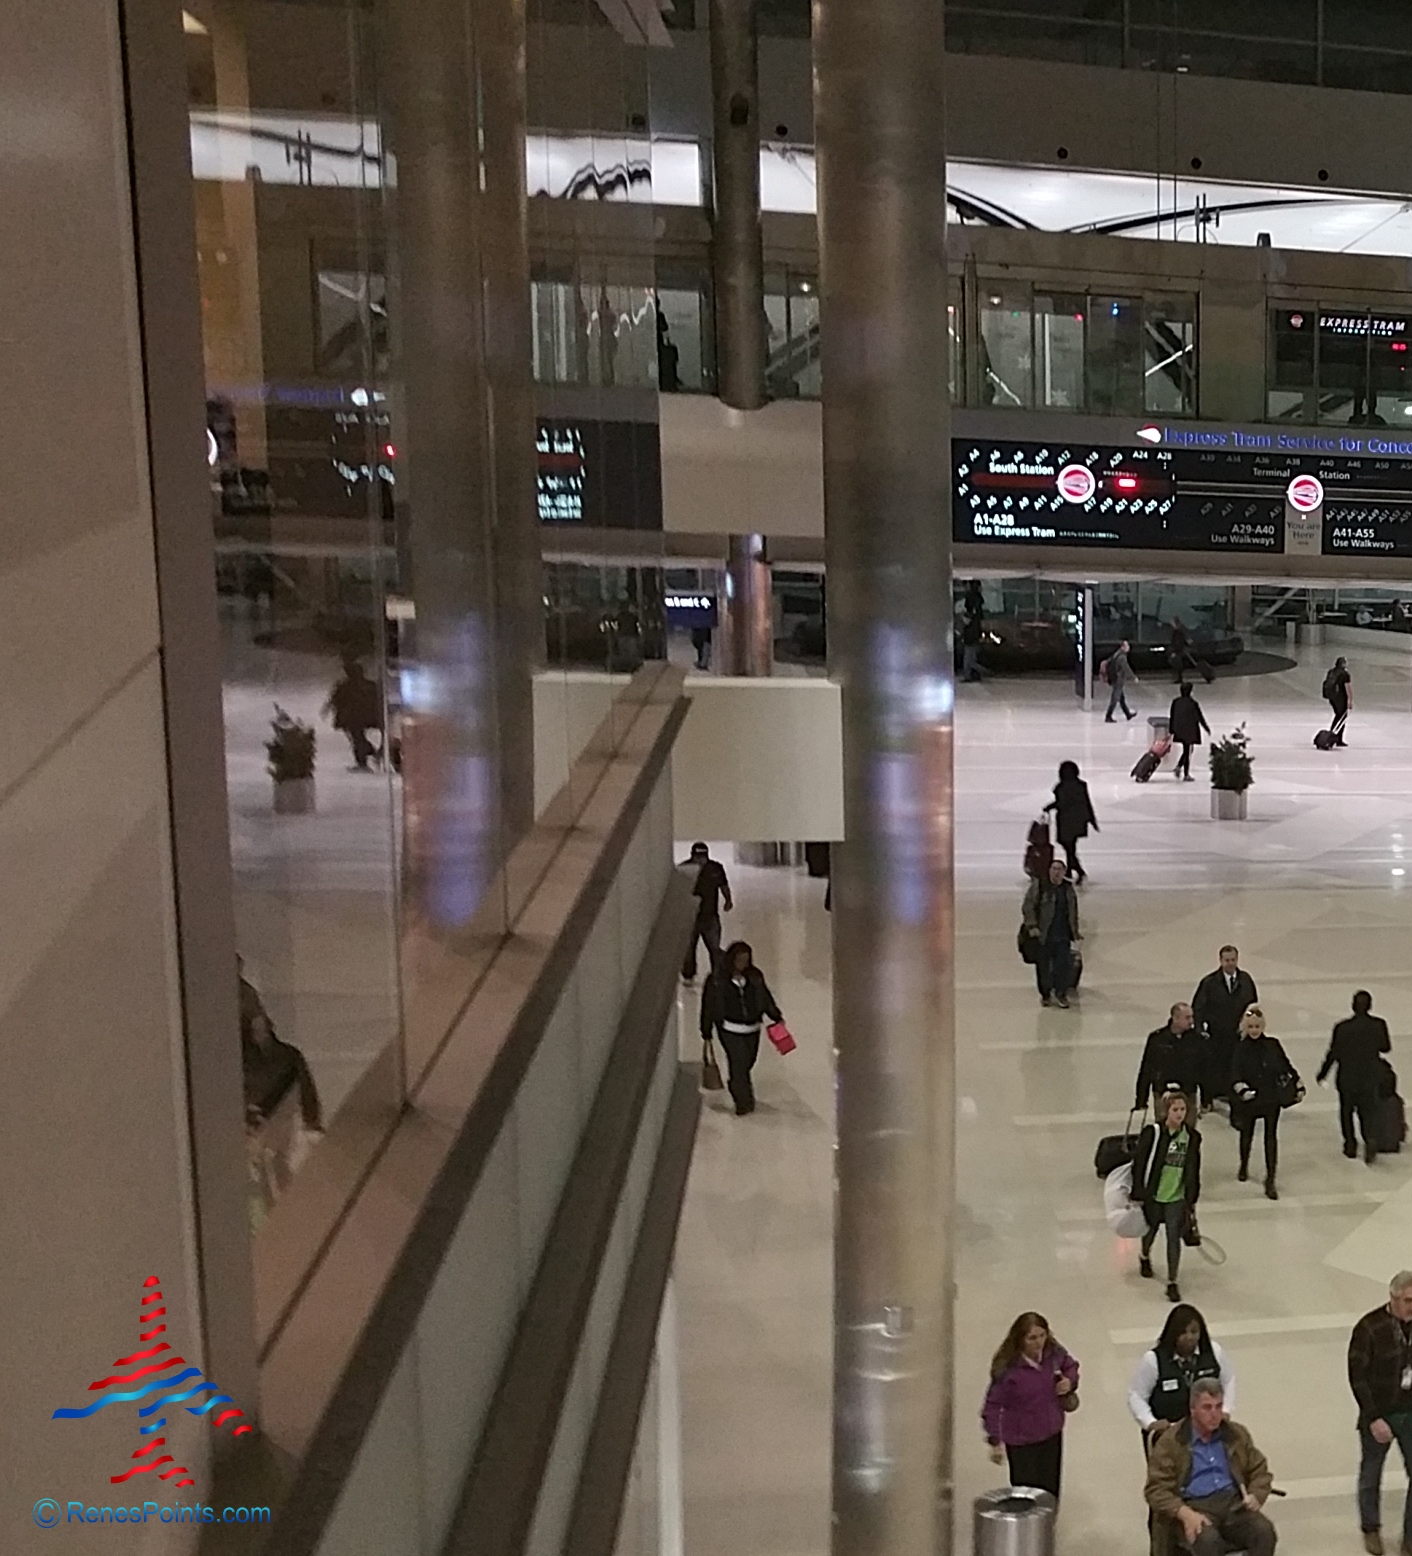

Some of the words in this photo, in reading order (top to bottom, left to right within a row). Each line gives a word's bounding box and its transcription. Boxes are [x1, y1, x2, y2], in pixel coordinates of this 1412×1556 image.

[1320, 317, 1369, 329] EXPRESS
[1373, 320, 1405, 331] TRAM
[1164, 427, 1227, 447] Express
[1232, 431, 1271, 447] Tram
[1278, 433, 1335, 449] Service
[1339, 437, 1363, 452] for
[1132, 450, 1148, 459] A24
[1156, 452, 1172, 460] A28
[989, 462, 1018, 474] South
[1020, 463, 1054, 475] Station
[1320, 459, 1334, 467] A40
[1253, 467, 1290, 477] Terminal
[1319, 470, 1350, 480] Station
[973, 512, 1015, 526] A1-A28
[1231, 524, 1275, 535] A29-A40
[1287, 521, 1305, 530] You
[974, 525, 992, 535] Use
[994, 525, 1030, 538] Express
[1031, 526, 1056, 538] Tram
[1293, 530, 1316, 539] Here
[1333, 528, 1375, 538] A41-A55
[1211, 534, 1228, 543] Use
[1229, 535, 1274, 546] Walkways
[1333, 539, 1348, 547] Use
[1350, 539, 1394, 550] Walkways
